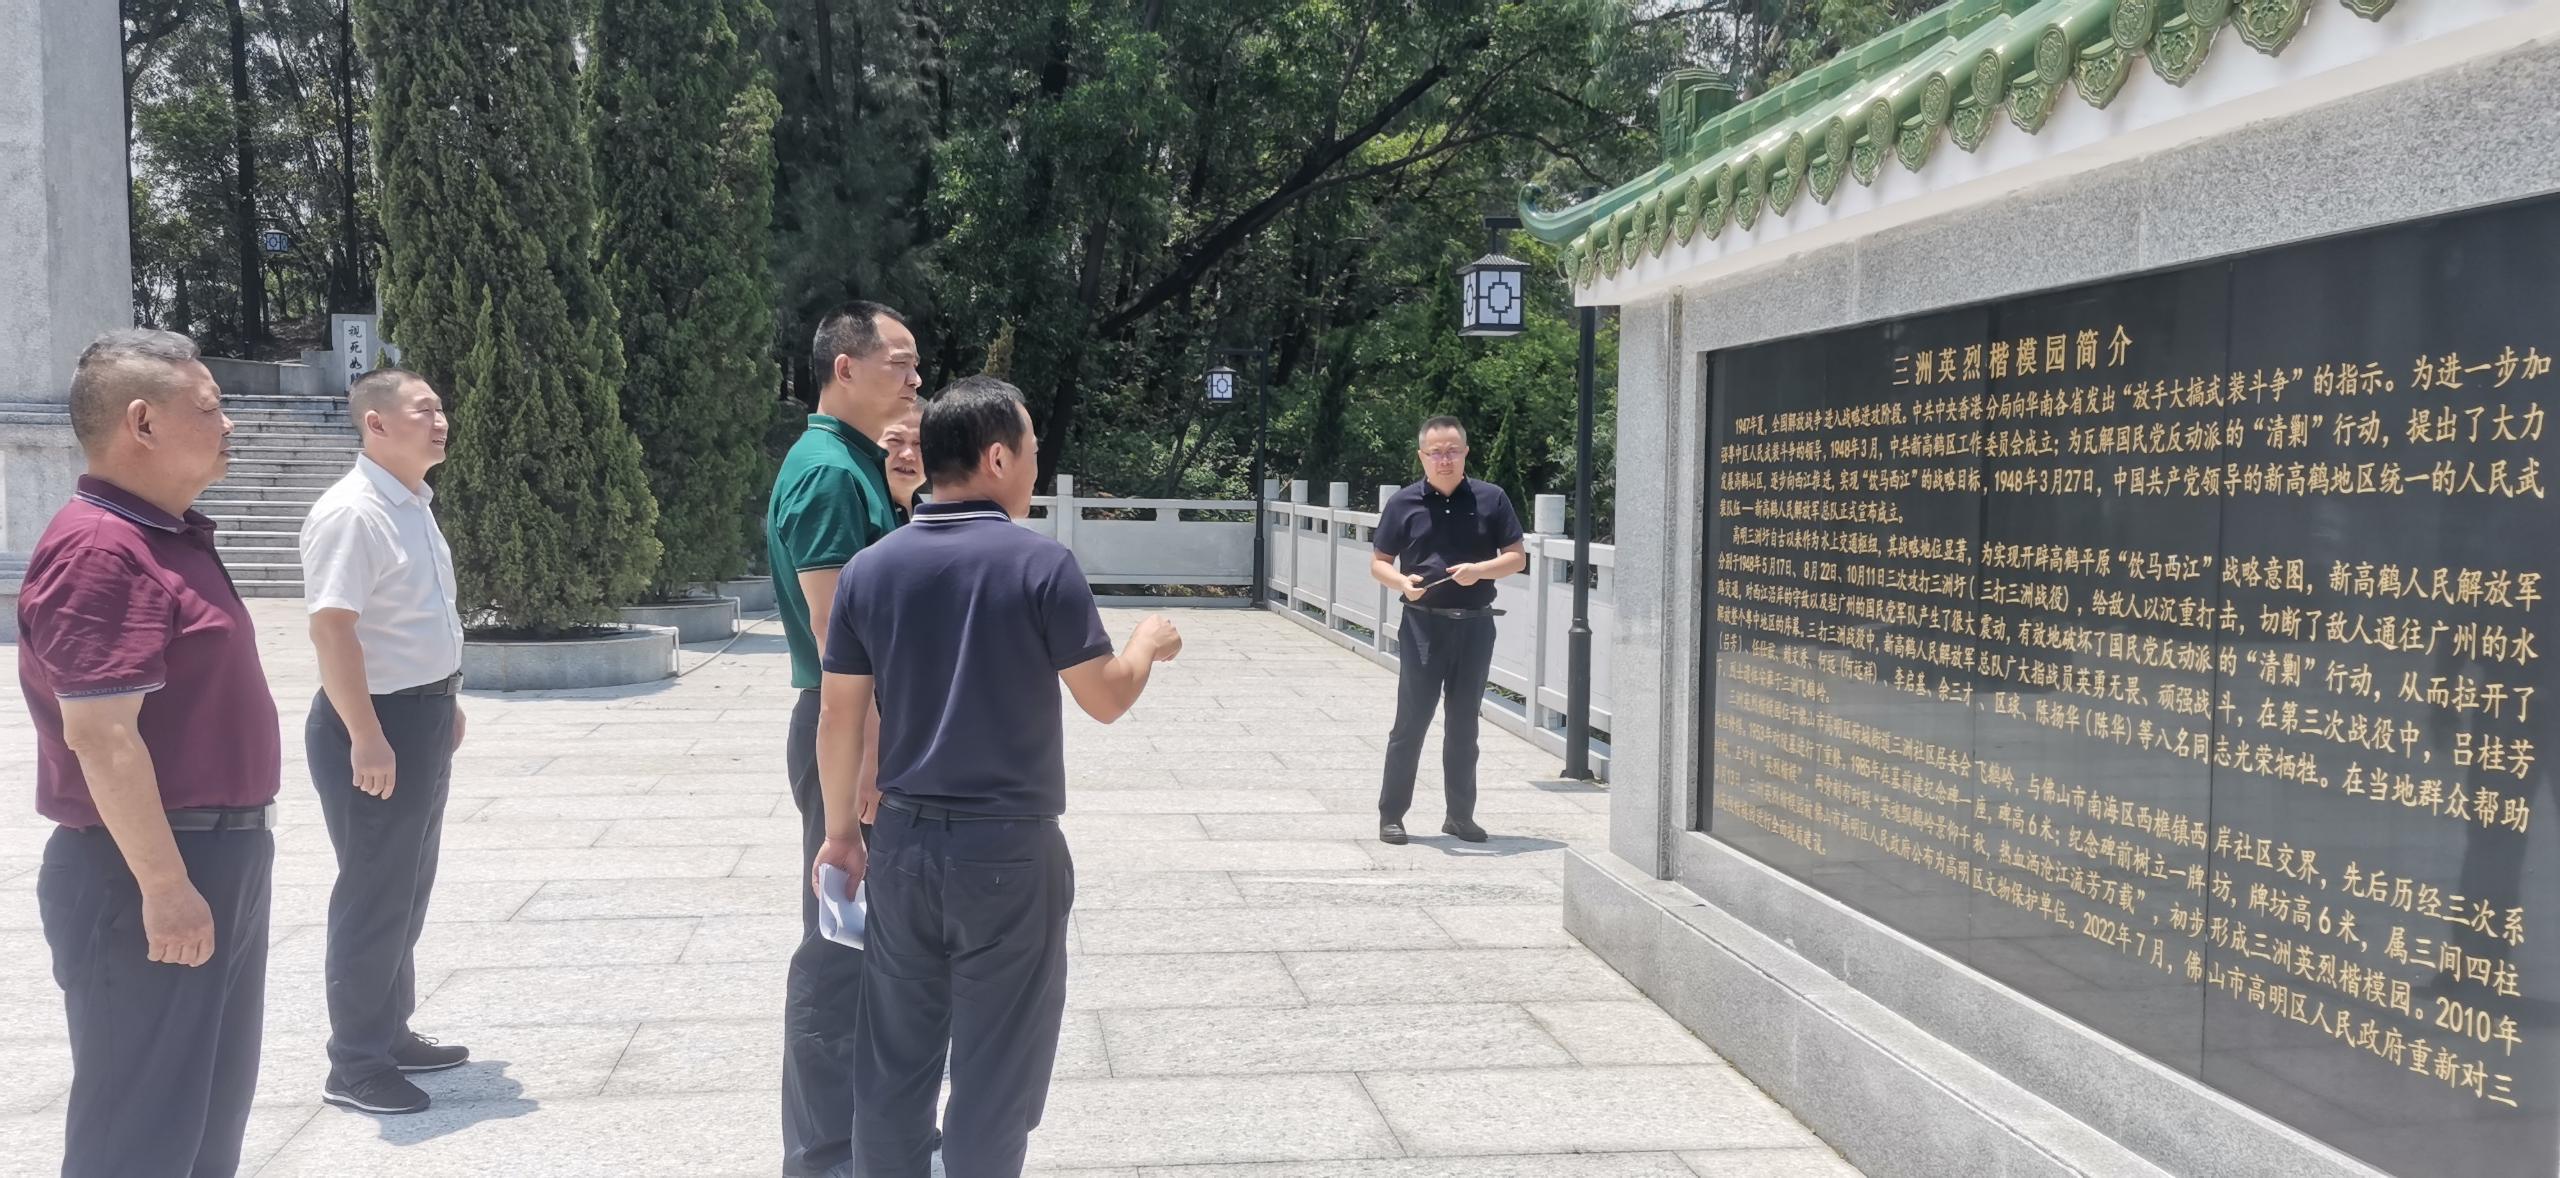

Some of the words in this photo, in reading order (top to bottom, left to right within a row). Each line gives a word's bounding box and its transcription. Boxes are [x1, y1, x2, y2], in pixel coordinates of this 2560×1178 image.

[1892, 324, 2133, 387] 三洲英烈楷模园简介
